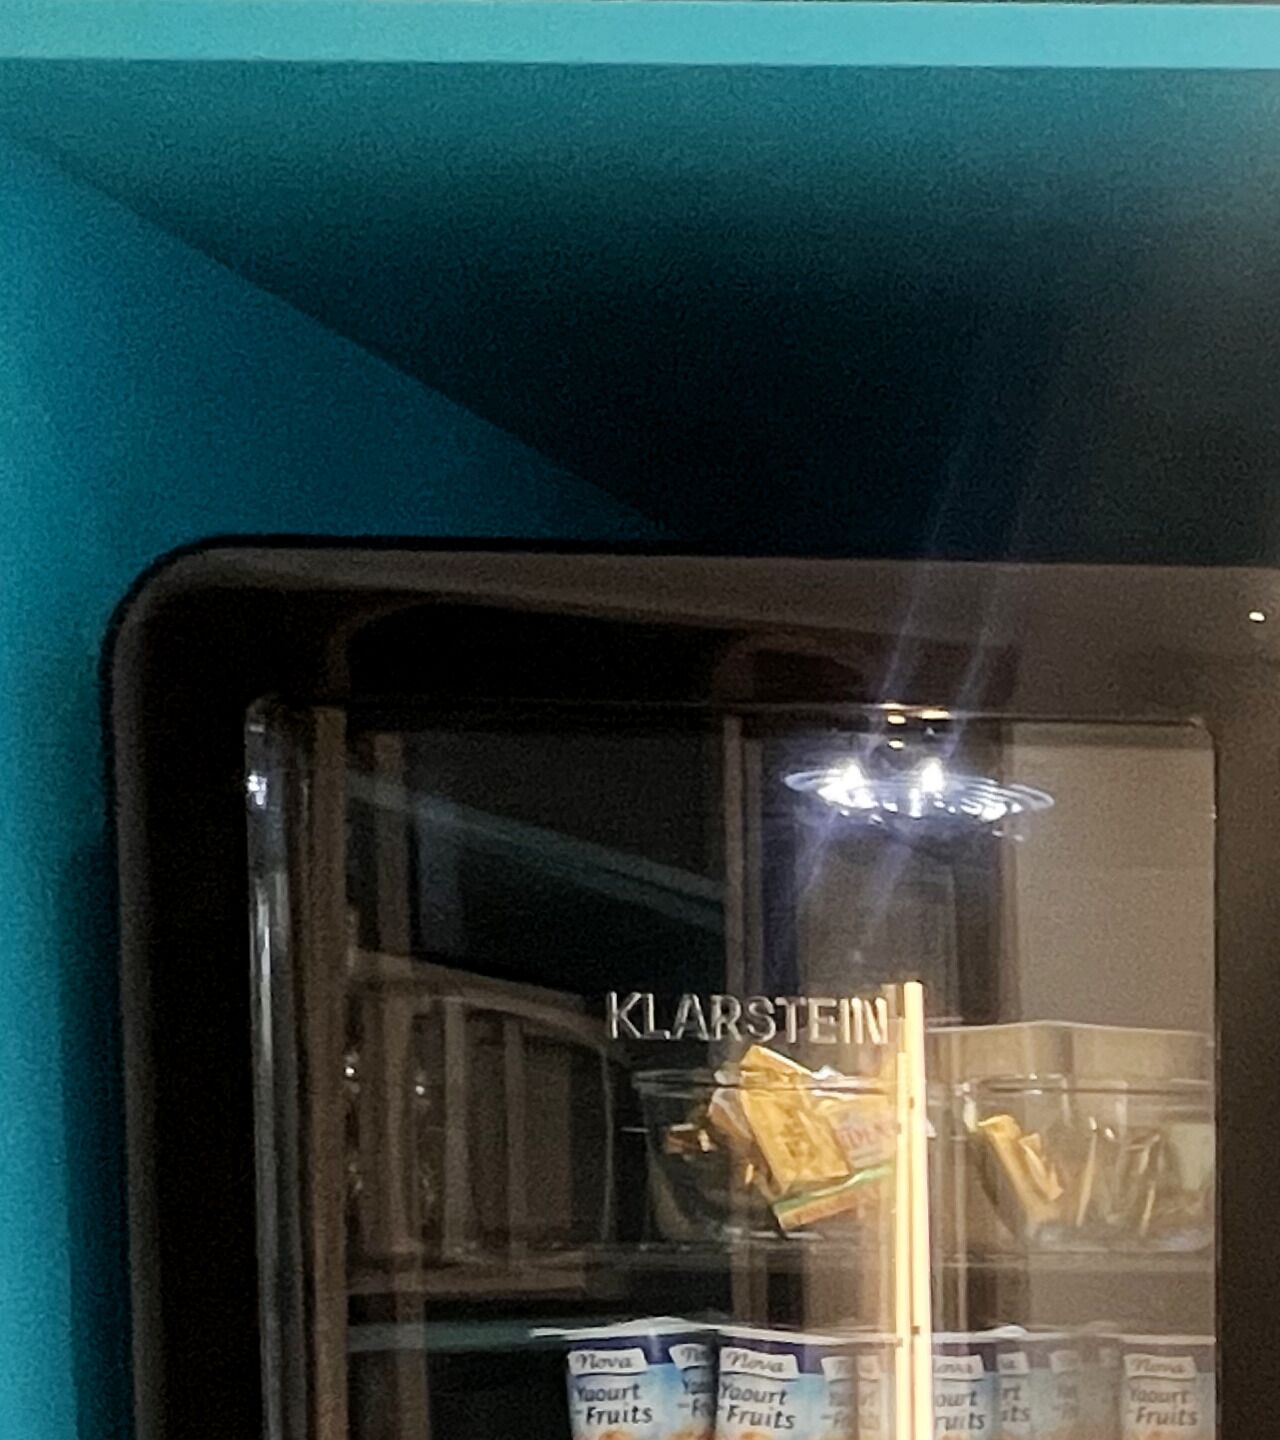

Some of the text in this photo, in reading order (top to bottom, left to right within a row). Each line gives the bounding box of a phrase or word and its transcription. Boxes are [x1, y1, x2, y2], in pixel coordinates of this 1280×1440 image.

[608, 991, 889, 1045] KLARSTEIN
[576, 1383, 642, 1402] Yaourt
[720, 1381, 788, 1405] Yaourt
[586, 1406, 654, 1426] Fruits
[726, 1404, 797, 1430] Fruits
